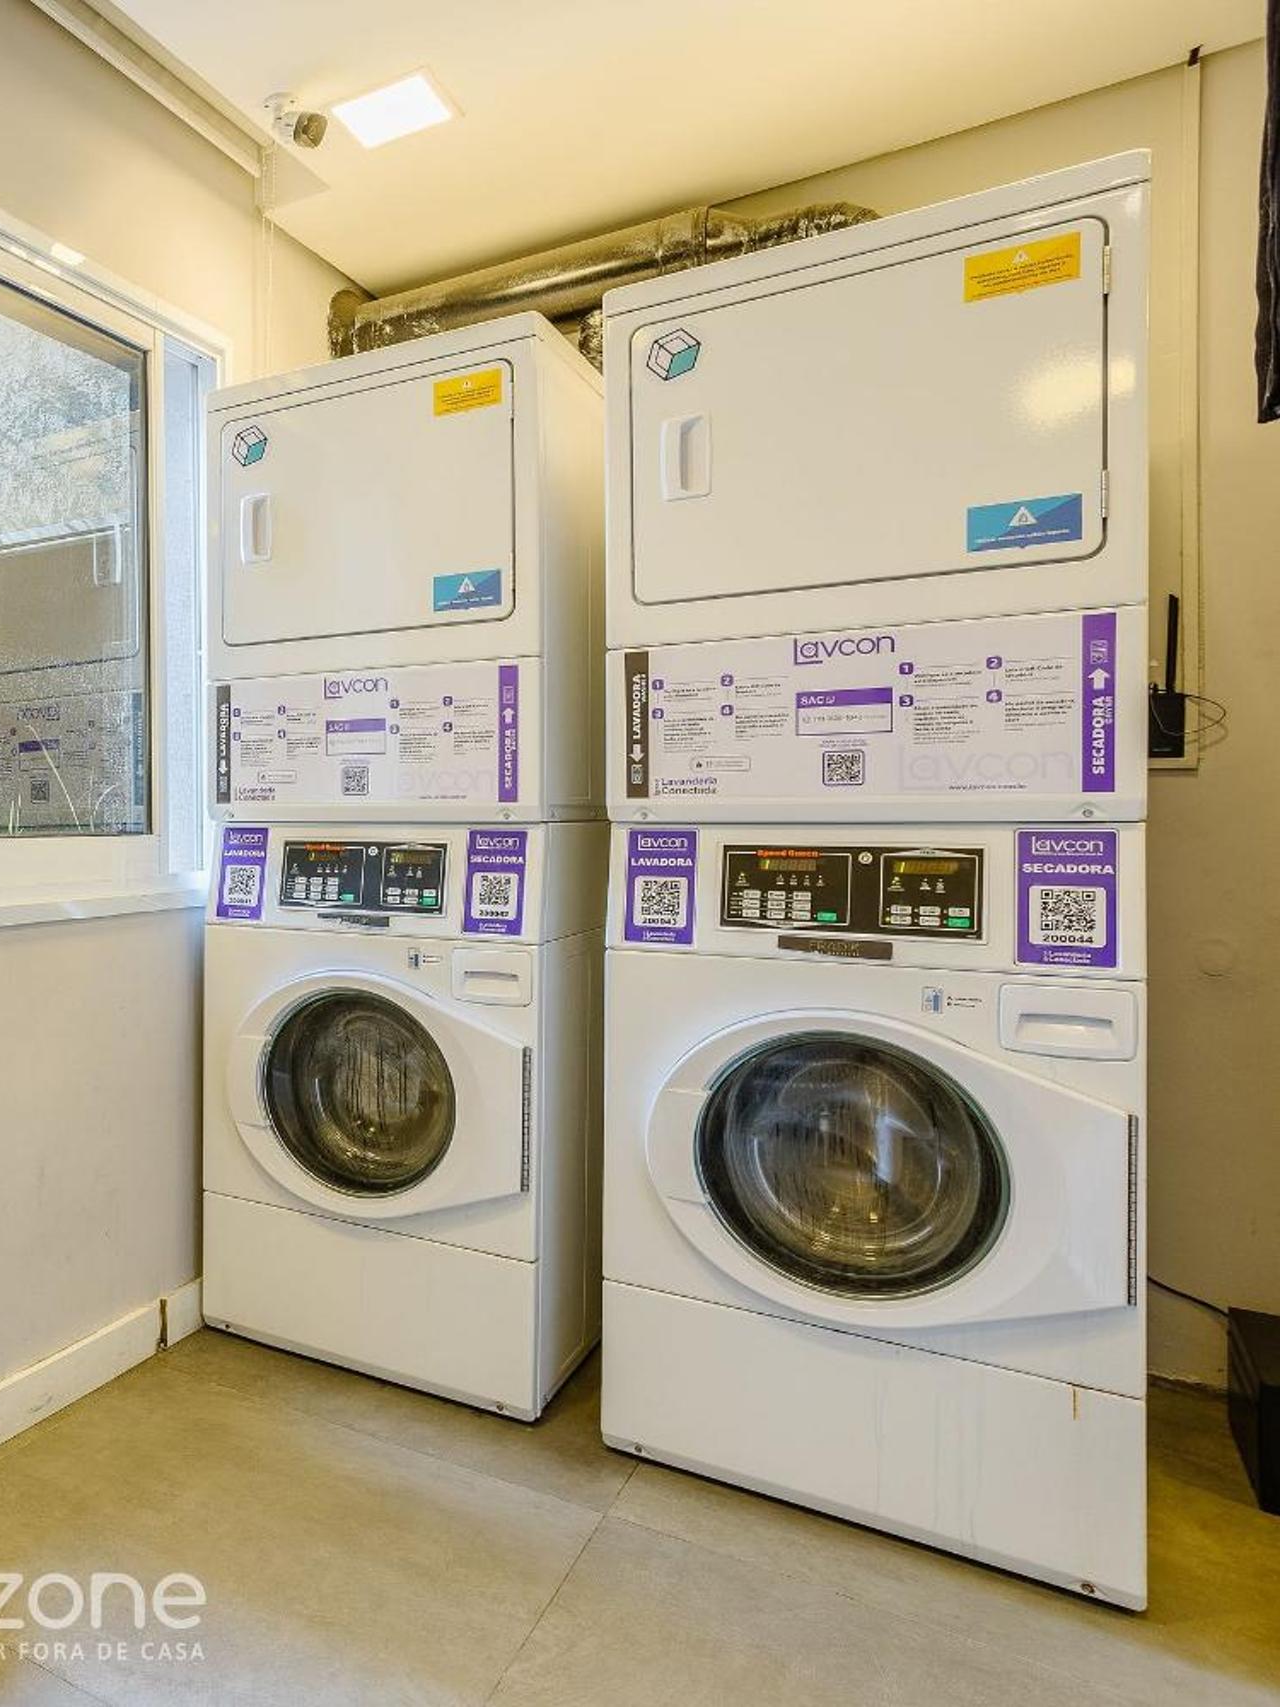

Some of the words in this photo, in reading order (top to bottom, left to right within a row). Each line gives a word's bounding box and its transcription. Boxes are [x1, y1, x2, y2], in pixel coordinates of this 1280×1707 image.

[794, 636, 896, 665] Lavcon
[632, 673, 642, 740] LAVADORA
[1092, 696, 1105, 775] SECADORA
[1031, 836, 1104, 855] Lavcon
[470, 855, 524, 864] SECADORA
[631, 858, 693, 866] LAVADORA
[1022, 863, 1115, 874] SECADORA
[1042, 934, 1094, 943] 200044
